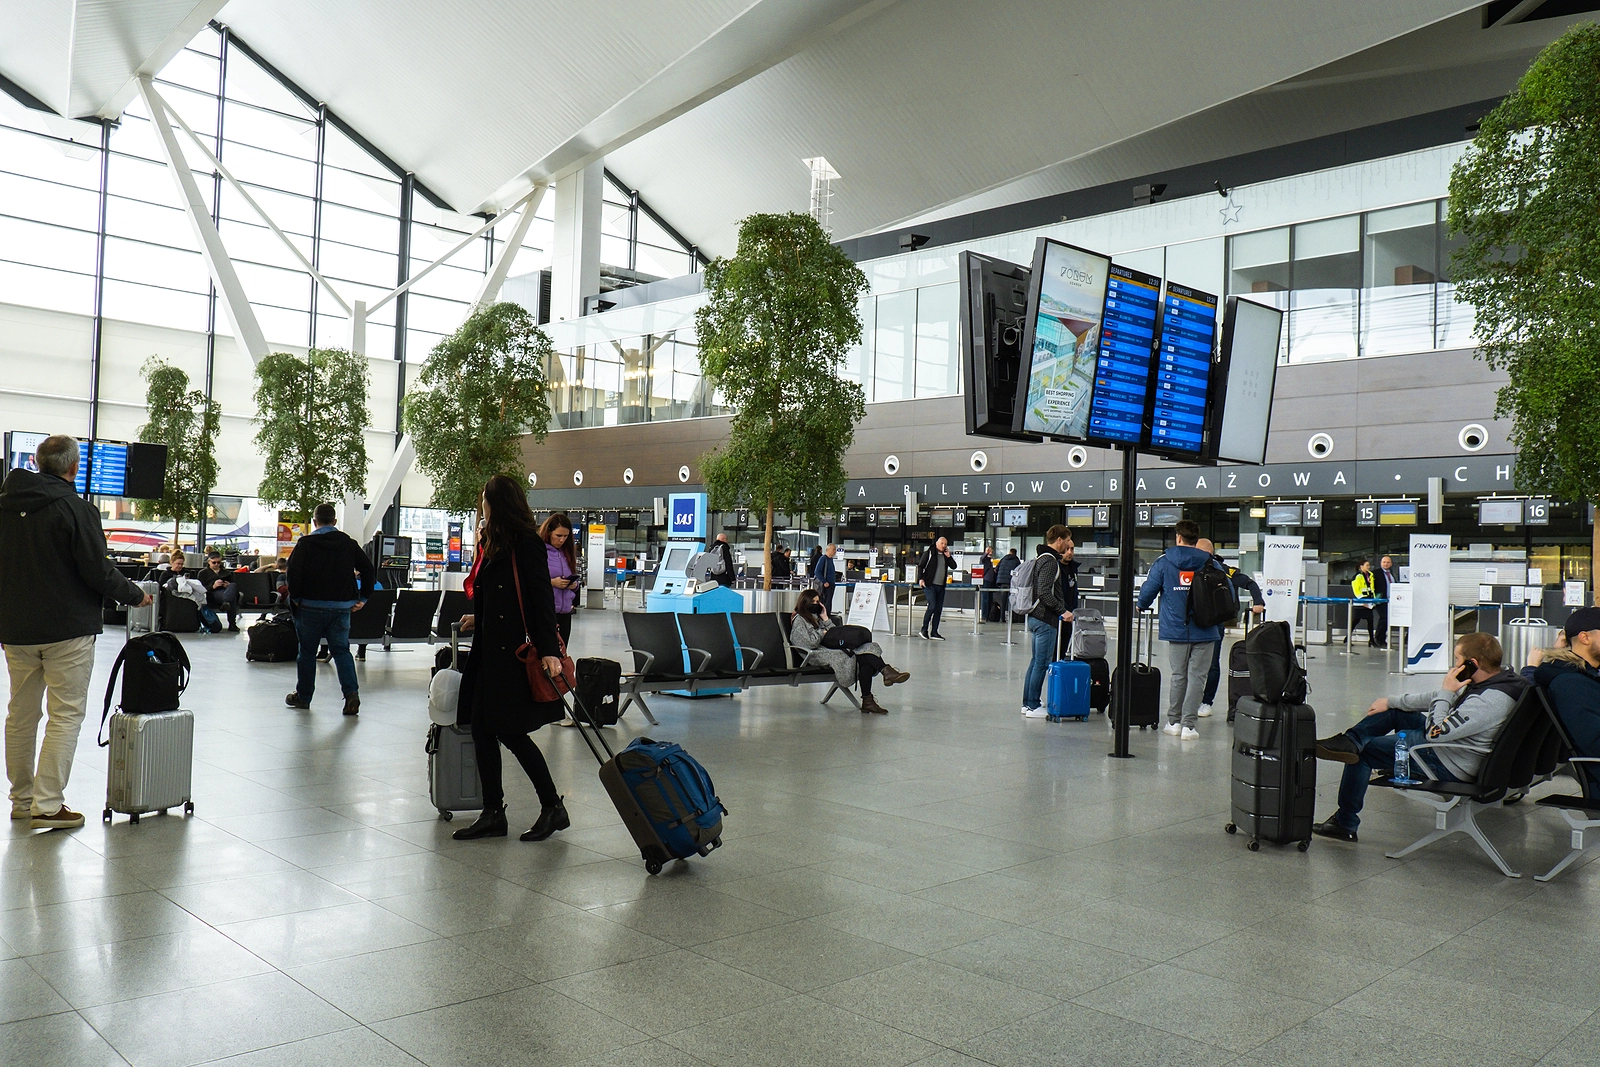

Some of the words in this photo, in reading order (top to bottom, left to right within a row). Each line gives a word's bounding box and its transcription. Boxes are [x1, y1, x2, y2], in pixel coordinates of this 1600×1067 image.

[1110, 266, 1133, 279] DEPARTURES
[1172, 285, 1192, 297] DEPARTURES
[1047, 399, 1071, 407] EXPERIENCE
[1097, 510, 1107, 521] 12
[1138, 510, 1149, 521] 13
[1306, 508, 1319, 520] 14
[1360, 507, 1373, 519] 15
[1529, 504, 1545, 518] 16
[581, 514, 586, 522] 2
[599, 514, 604, 522] 3
[673, 513, 694, 525] SAS
[740, 513, 745, 522] 6
[840, 513, 846, 523] 8
[869, 513, 875, 522] 9
[956, 512, 965, 521] 10
[992, 512, 999, 521] 11
